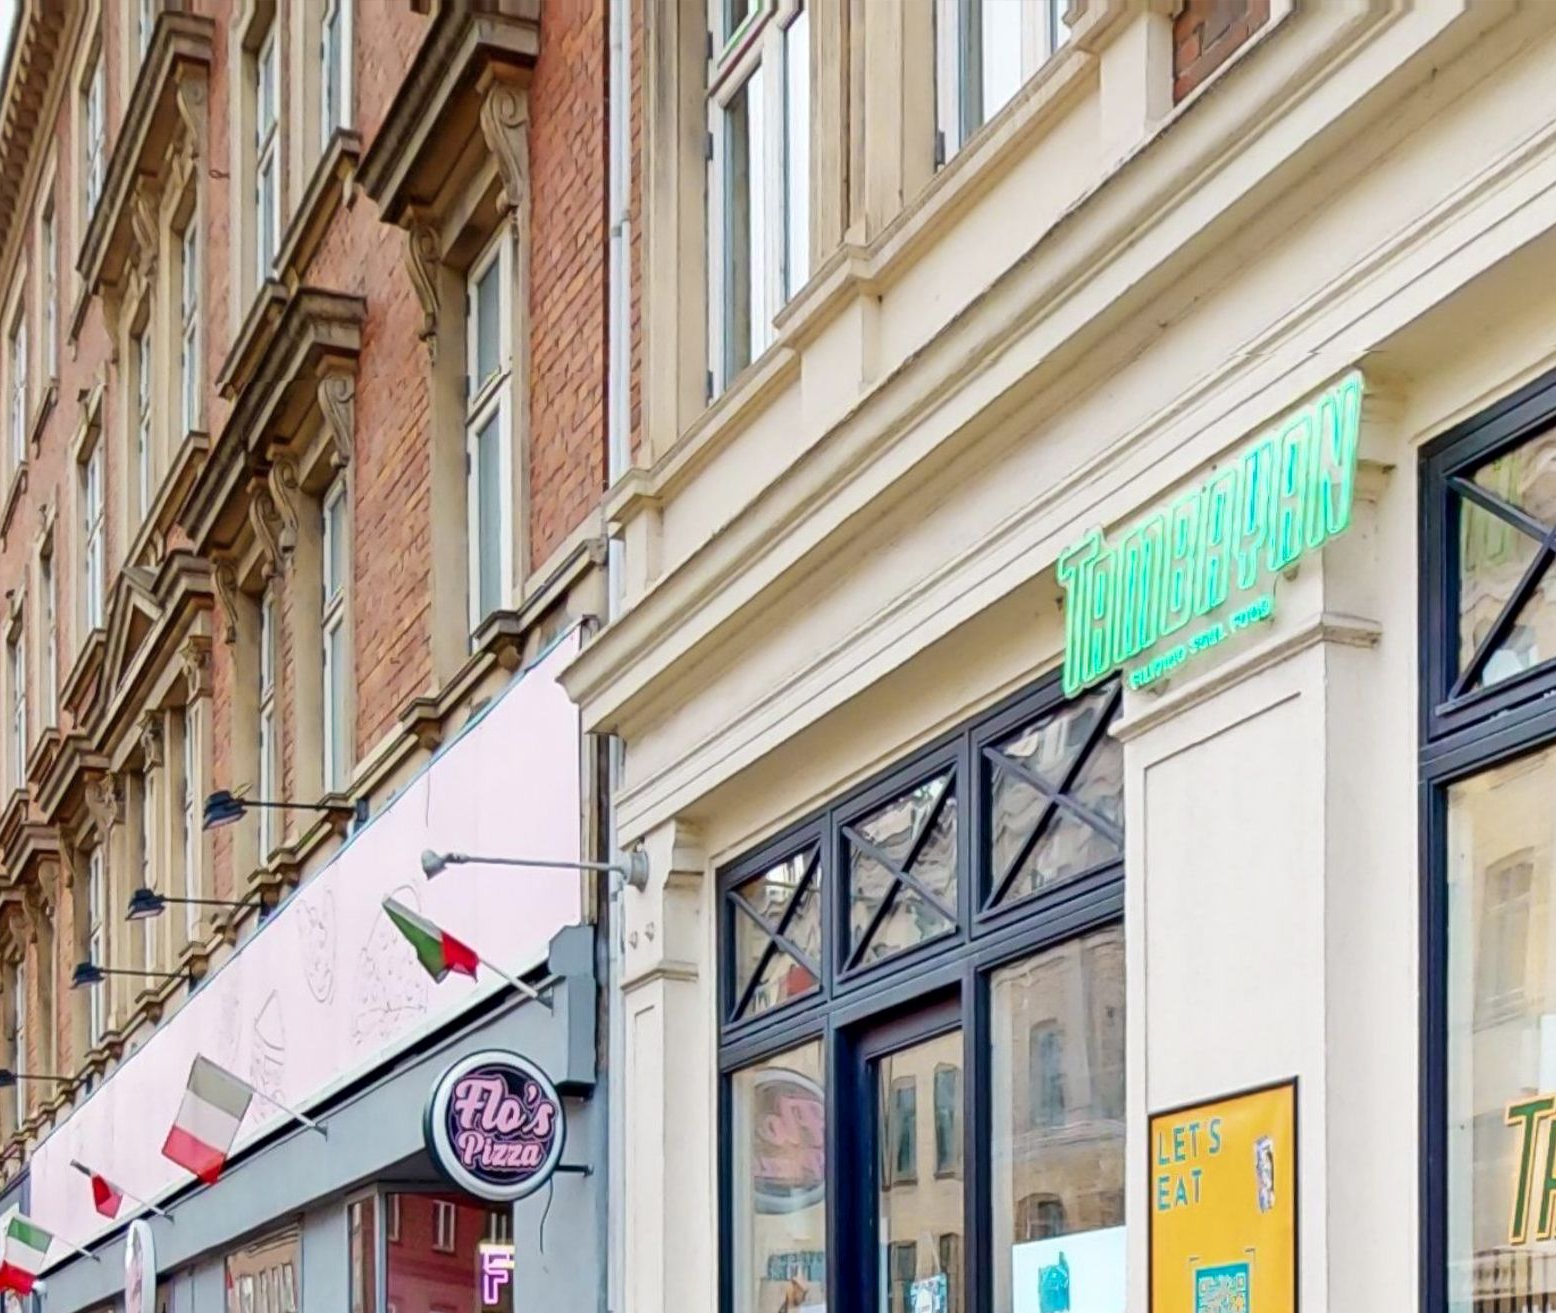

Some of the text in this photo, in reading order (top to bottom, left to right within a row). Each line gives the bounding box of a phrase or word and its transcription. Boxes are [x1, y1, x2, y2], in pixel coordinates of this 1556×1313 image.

[1058, 372, 1363, 697] TAMBAYAN
[454, 1077, 555, 1136] Flo's
[458, 1132, 542, 1166] Pizza
[1157, 1168, 1203, 1211] EAT
